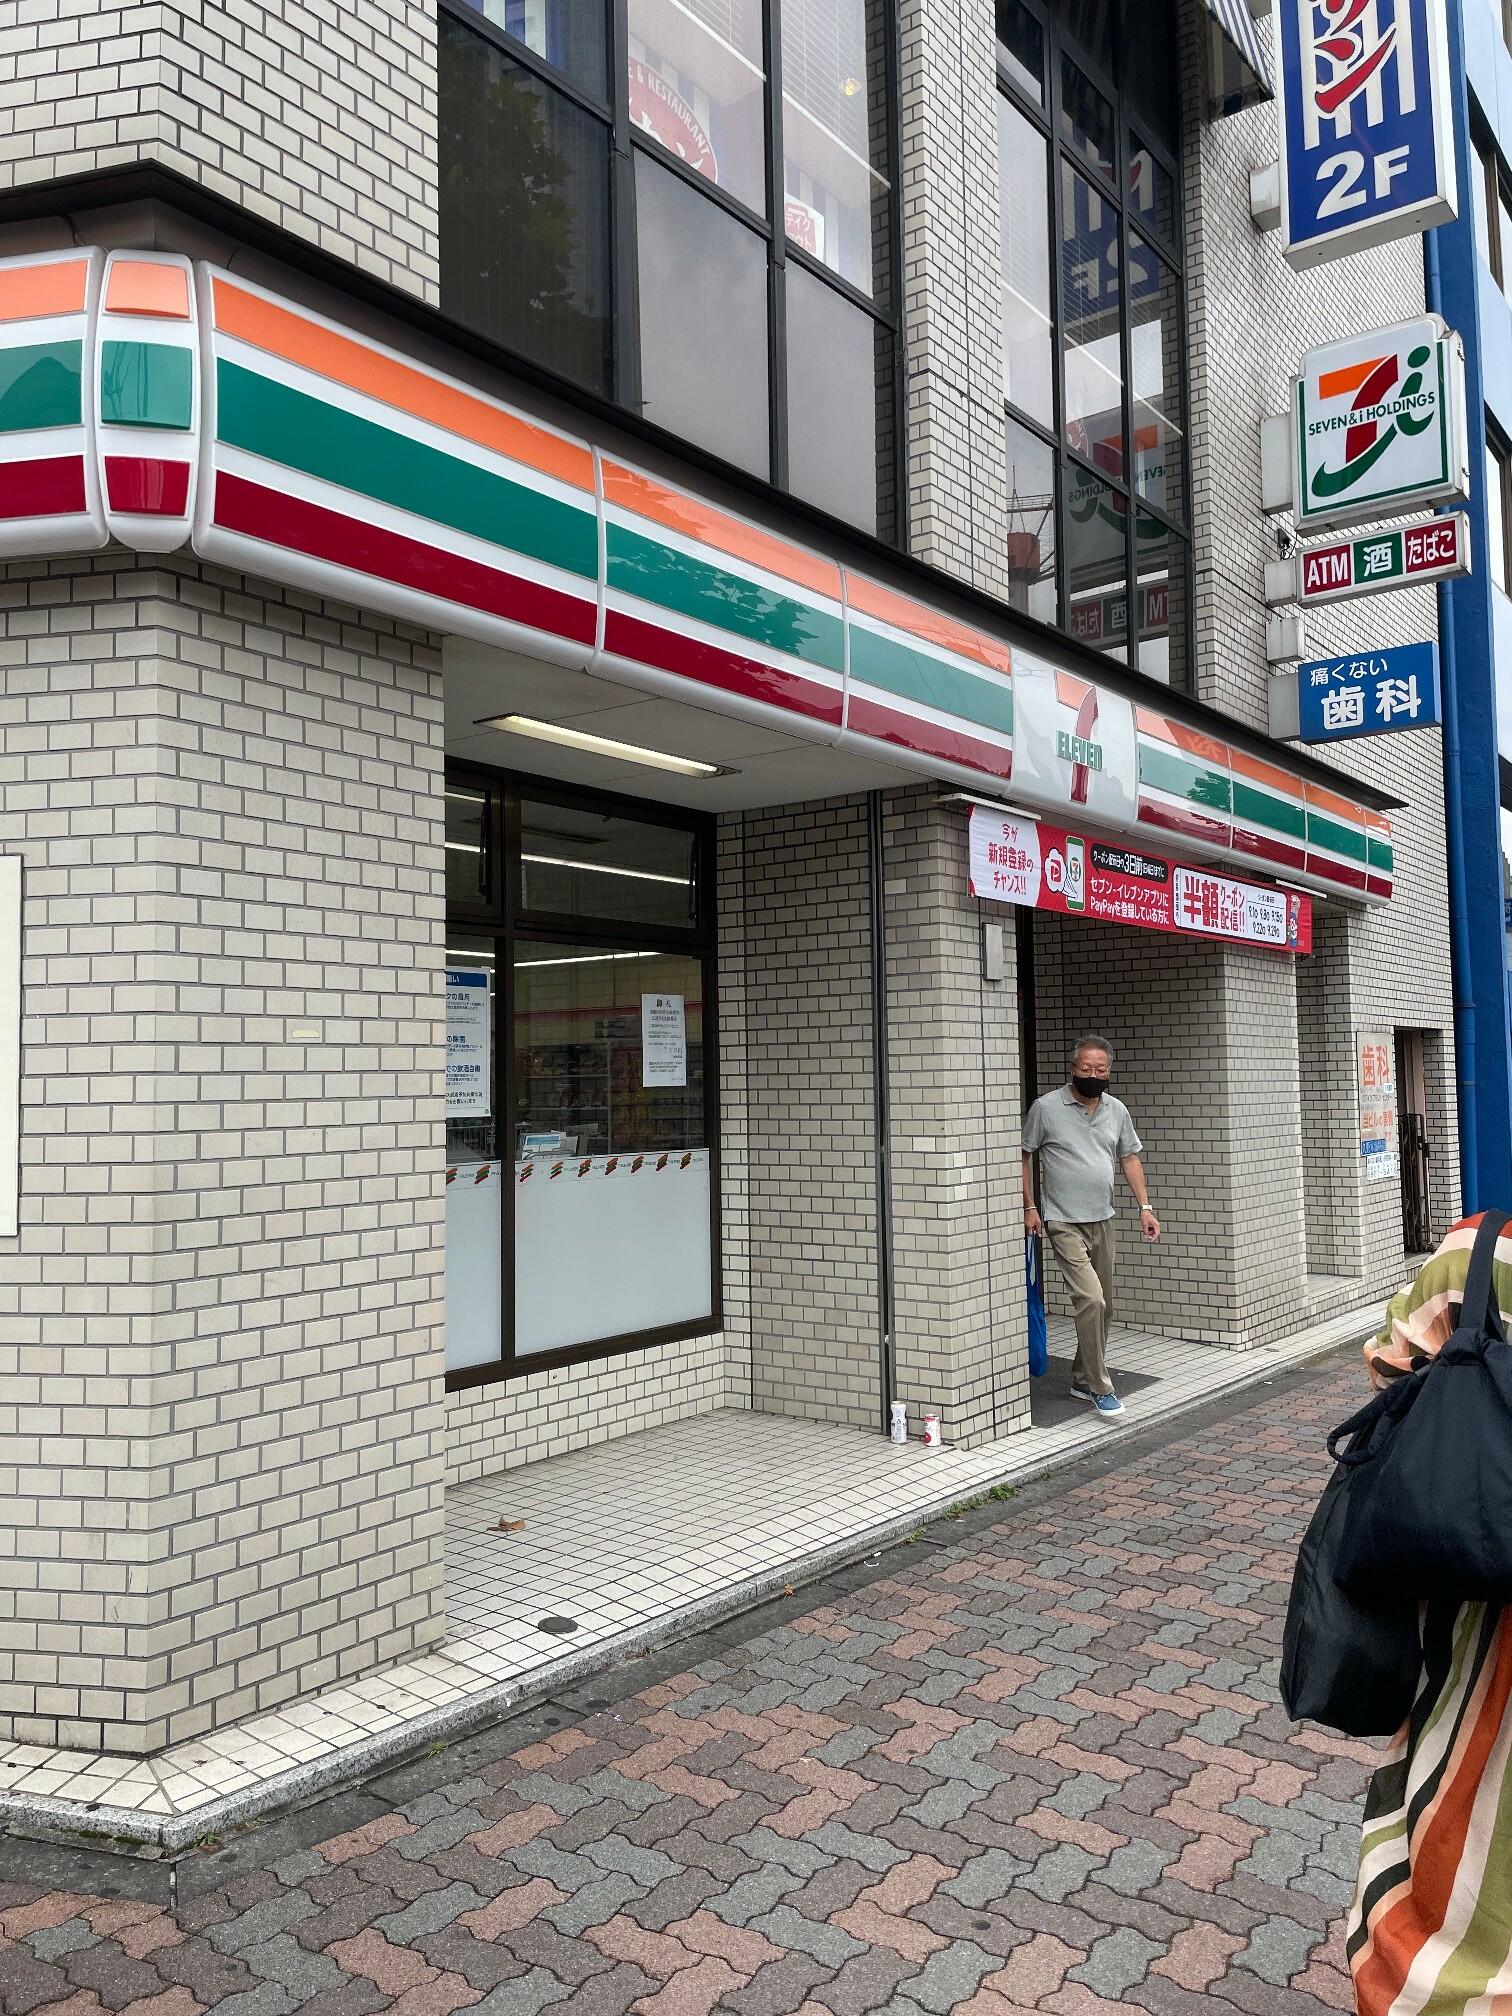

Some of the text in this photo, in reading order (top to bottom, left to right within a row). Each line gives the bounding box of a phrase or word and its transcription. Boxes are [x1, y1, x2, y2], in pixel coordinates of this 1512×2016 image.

[648, 73, 711, 155] RESTAURANT
[1316, 145, 1410, 220] 2F
[1366, 391, 1435, 420] HOLDINGS
[1363, 541, 1393, 577] 酒
[1408, 530, 1455, 566] たばこ
[1307, 552, 1348, 588] ATM
[1310, 658, 1388, 686] 痛くない
[1320, 675, 1421, 730] 歯科
[988, 842, 1034, 872] 新規登録の
[1183, 876, 1219, 929] 半額
[1220, 885, 1245, 909] クーポン
[1362, 1044, 1390, 1087] 歯科
